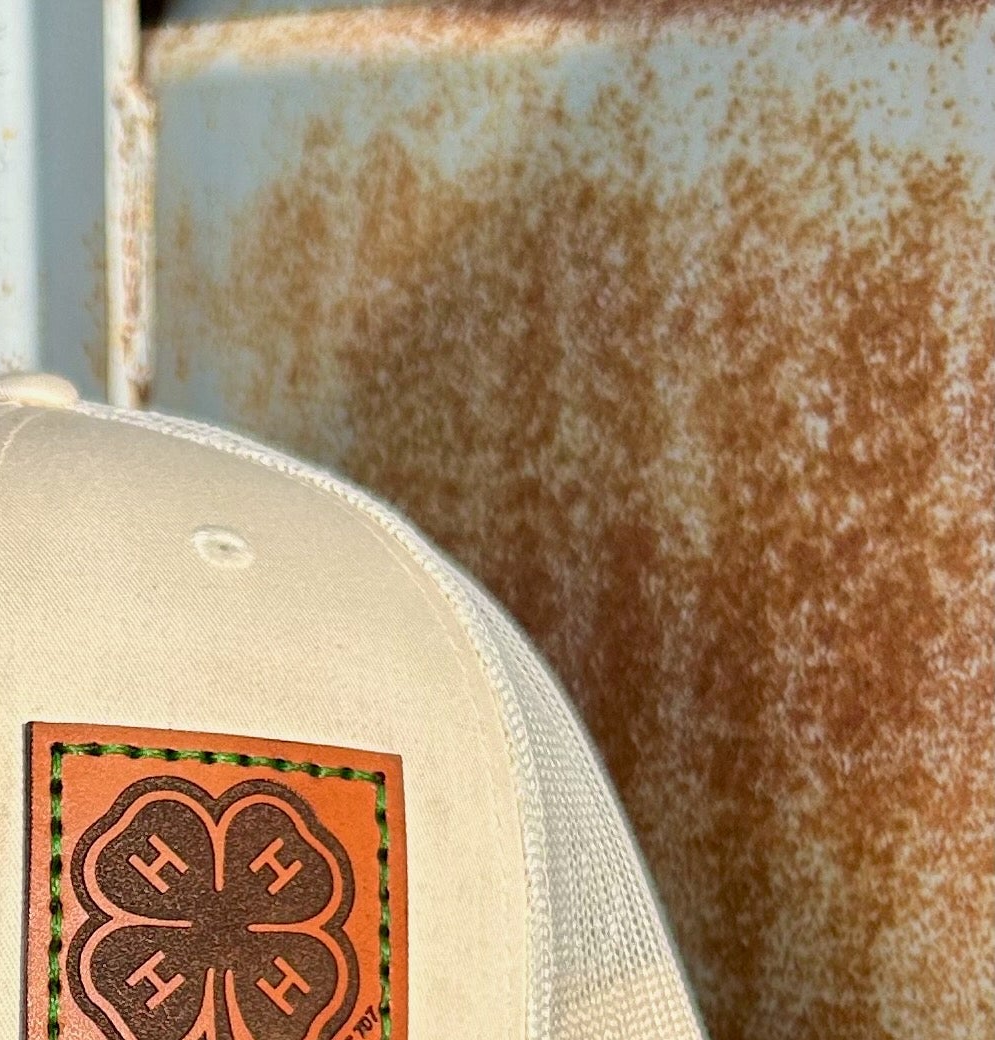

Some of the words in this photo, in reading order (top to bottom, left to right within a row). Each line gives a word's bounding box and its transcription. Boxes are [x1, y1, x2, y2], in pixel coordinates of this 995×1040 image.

[127, 833, 189, 894] H
[248, 836, 303, 896] H
[124, 949, 186, 1011] H
[255, 955, 311, 1016] H
[352, 1004, 379, 1040] 707
